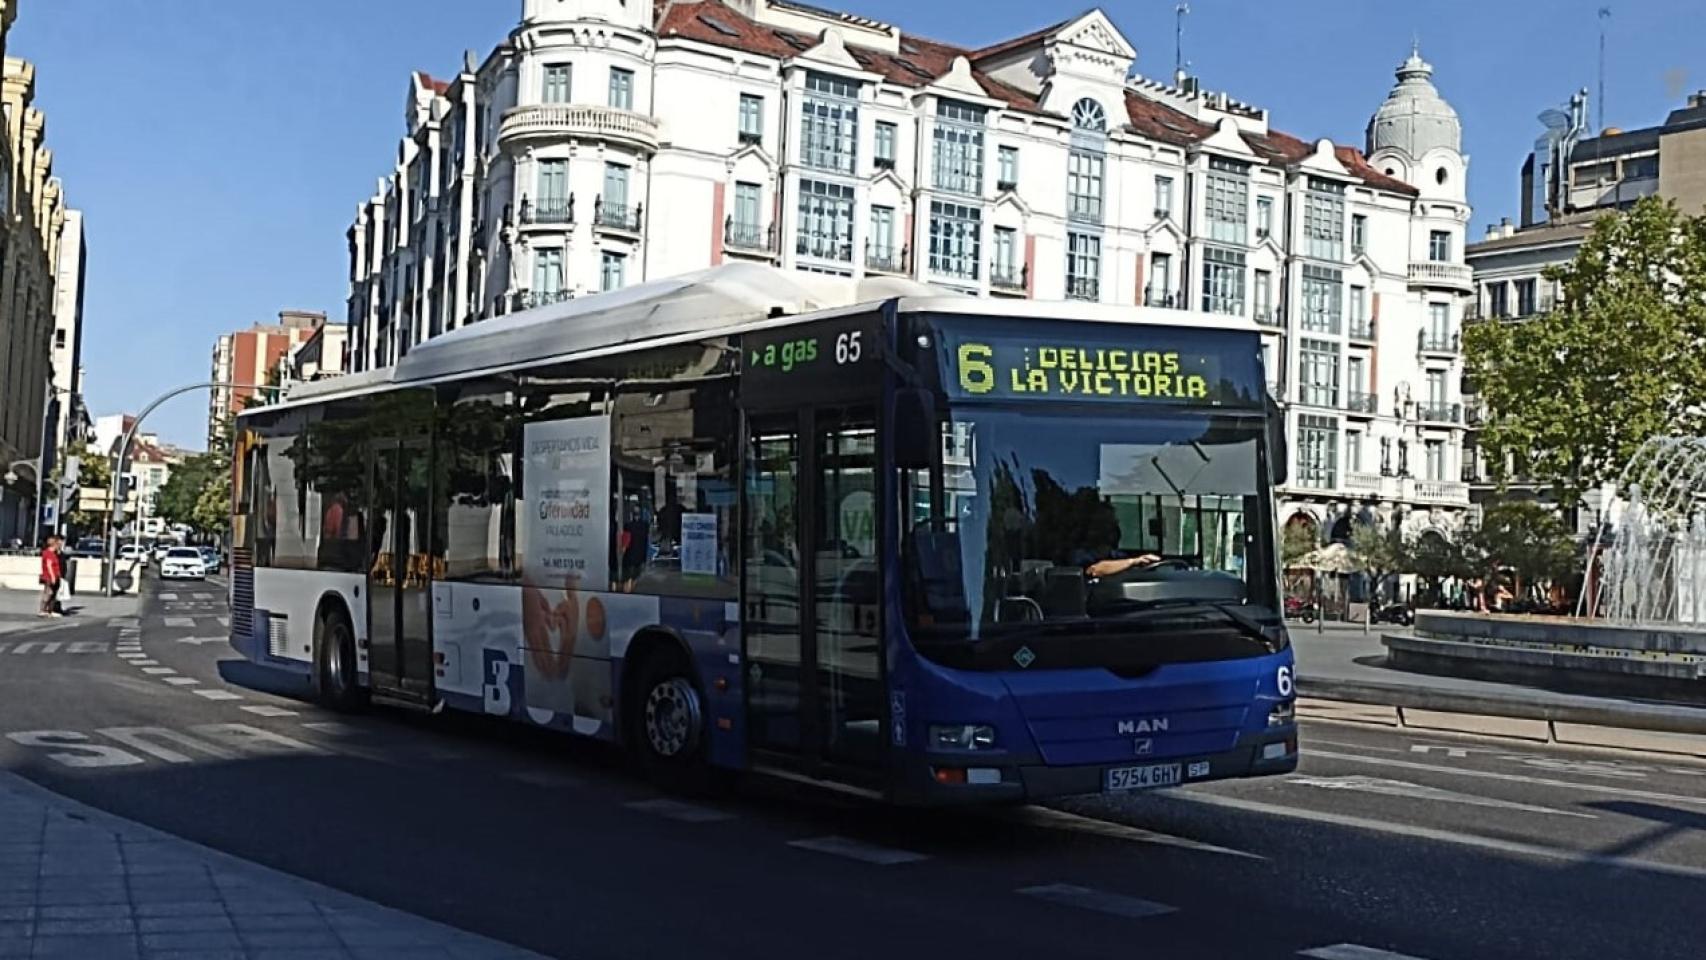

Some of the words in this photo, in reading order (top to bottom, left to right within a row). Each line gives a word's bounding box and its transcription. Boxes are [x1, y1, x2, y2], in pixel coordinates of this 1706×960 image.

[764, 344, 776, 366] a
[782, 338, 817, 372] gas
[835, 331, 863, 365] 65
[1039, 347, 1180, 374] DELICIAS
[958, 344, 994, 394] 6
[1012, 369, 1048, 393] LA
[1060, 371, 1209, 398] VICTORIA
[1118, 717, 1168, 734] MAN
[1112, 769, 1147, 788] 5754
[1152, 765, 1178, 784] GHY
